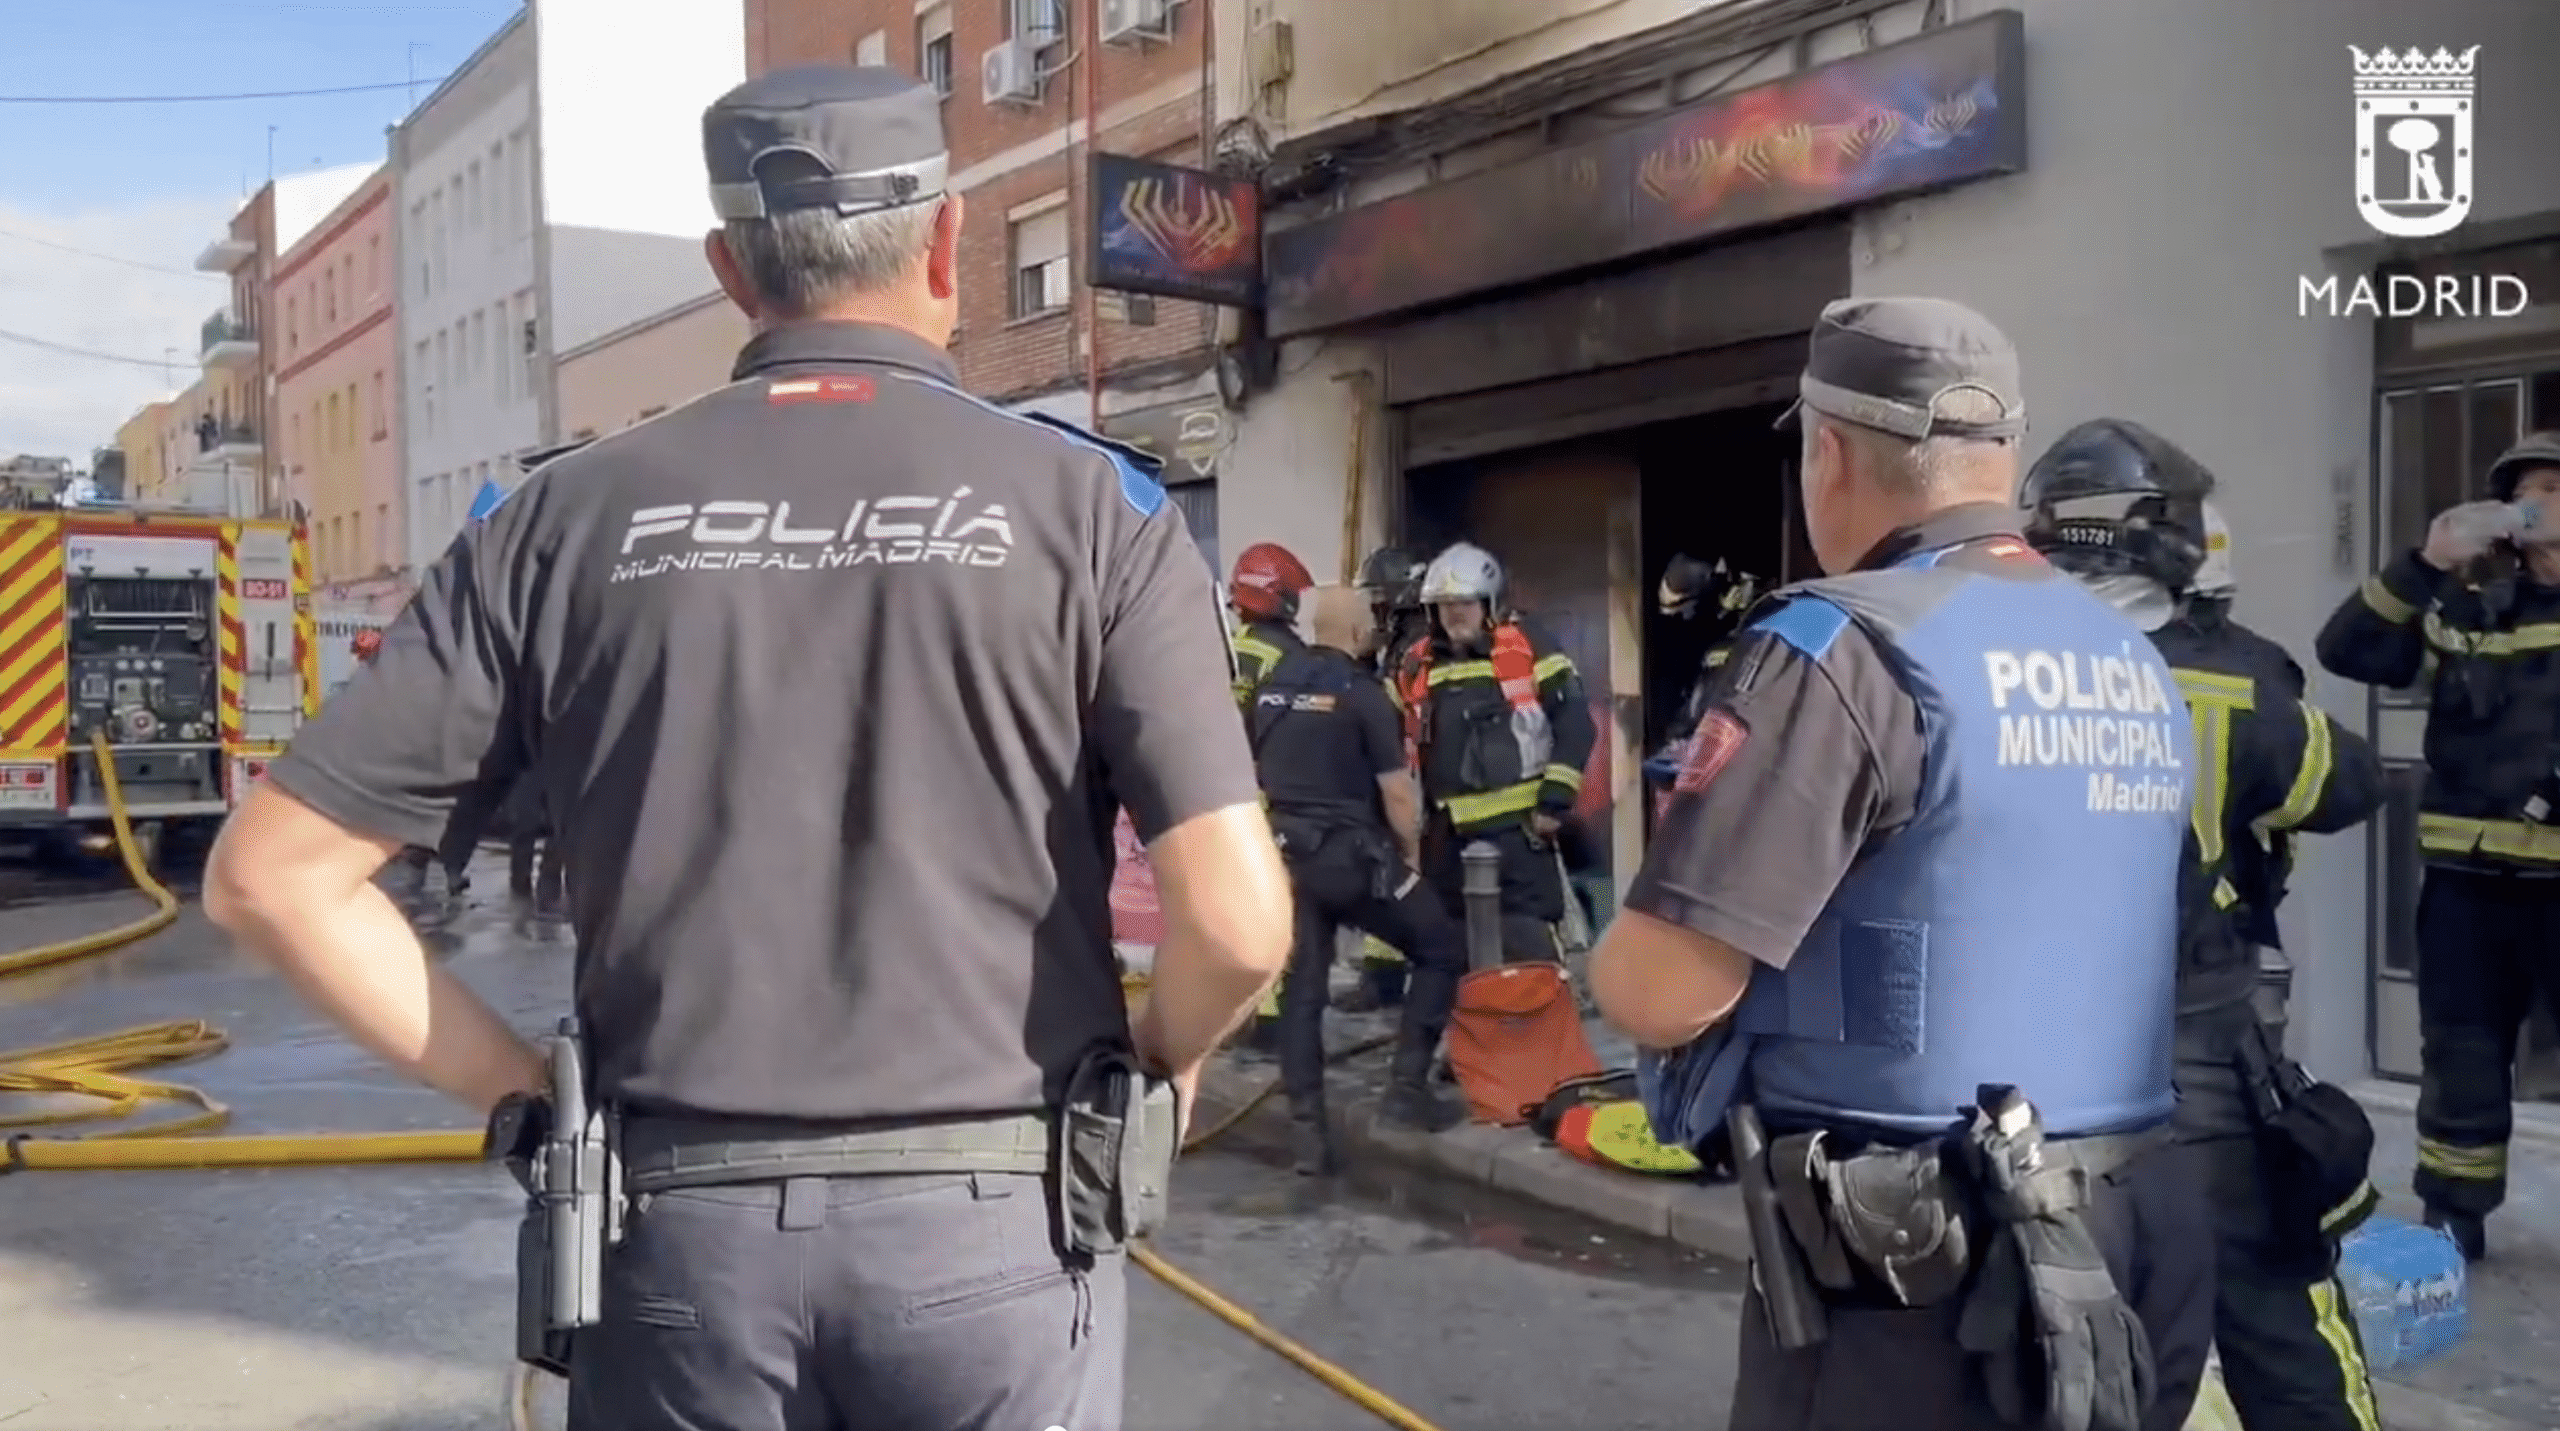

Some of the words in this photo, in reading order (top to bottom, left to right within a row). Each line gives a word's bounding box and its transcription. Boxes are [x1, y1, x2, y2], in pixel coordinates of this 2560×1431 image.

[620, 484, 1014, 555] POLICÍA
[2061, 526, 2115, 547] 151781
[610, 551, 813, 584] MUNICIPAL
[817, 540, 1009, 570] MADRID
[1984, 639, 2172, 716] POLICÍA
[1998, 714, 2182, 768] MUNICIPAL
[2086, 772, 2185, 812] Madrid
